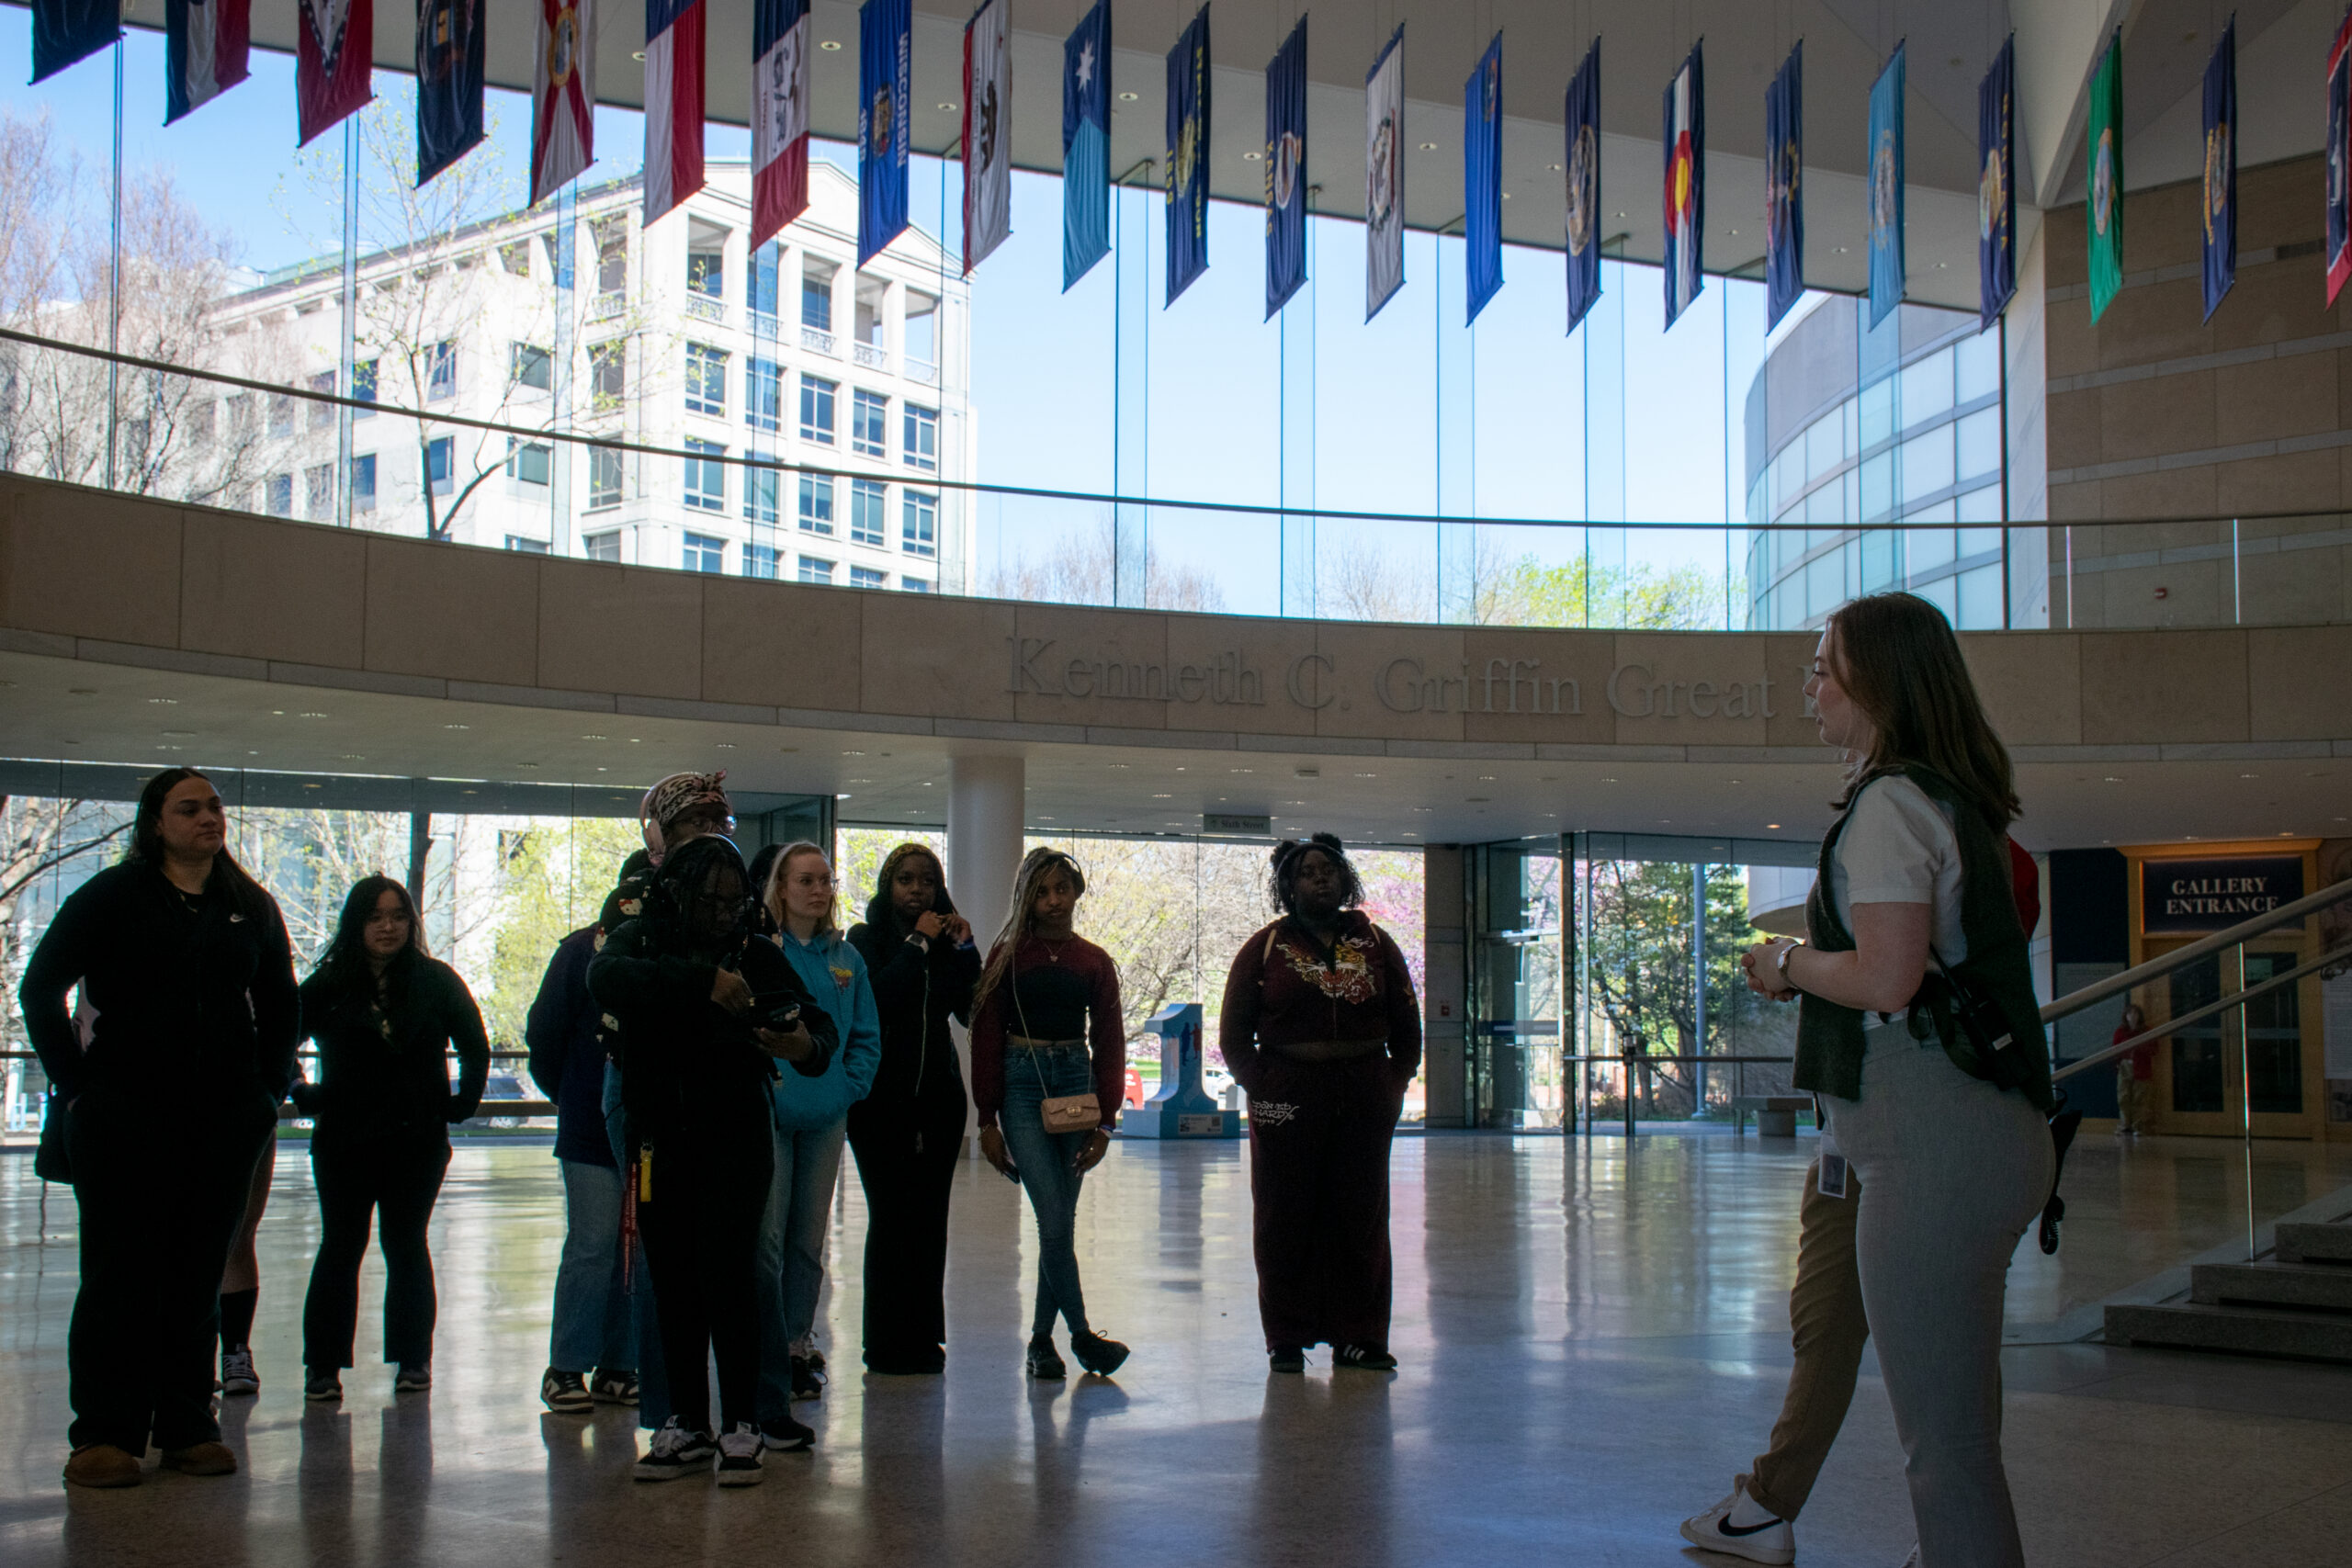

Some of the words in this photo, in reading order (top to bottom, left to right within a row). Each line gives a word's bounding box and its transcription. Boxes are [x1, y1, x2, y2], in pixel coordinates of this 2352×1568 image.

[897, 31, 909, 169] WISCONSIN
[1006, 637, 1265, 705] Kenneth
[1288, 655, 1351, 711] C.
[1375, 657, 1587, 716] Griffin
[1607, 663, 1778, 718] Great
[2166, 896, 2278, 915] ENTRANCE
[2171, 876, 2268, 896] GALLERY
